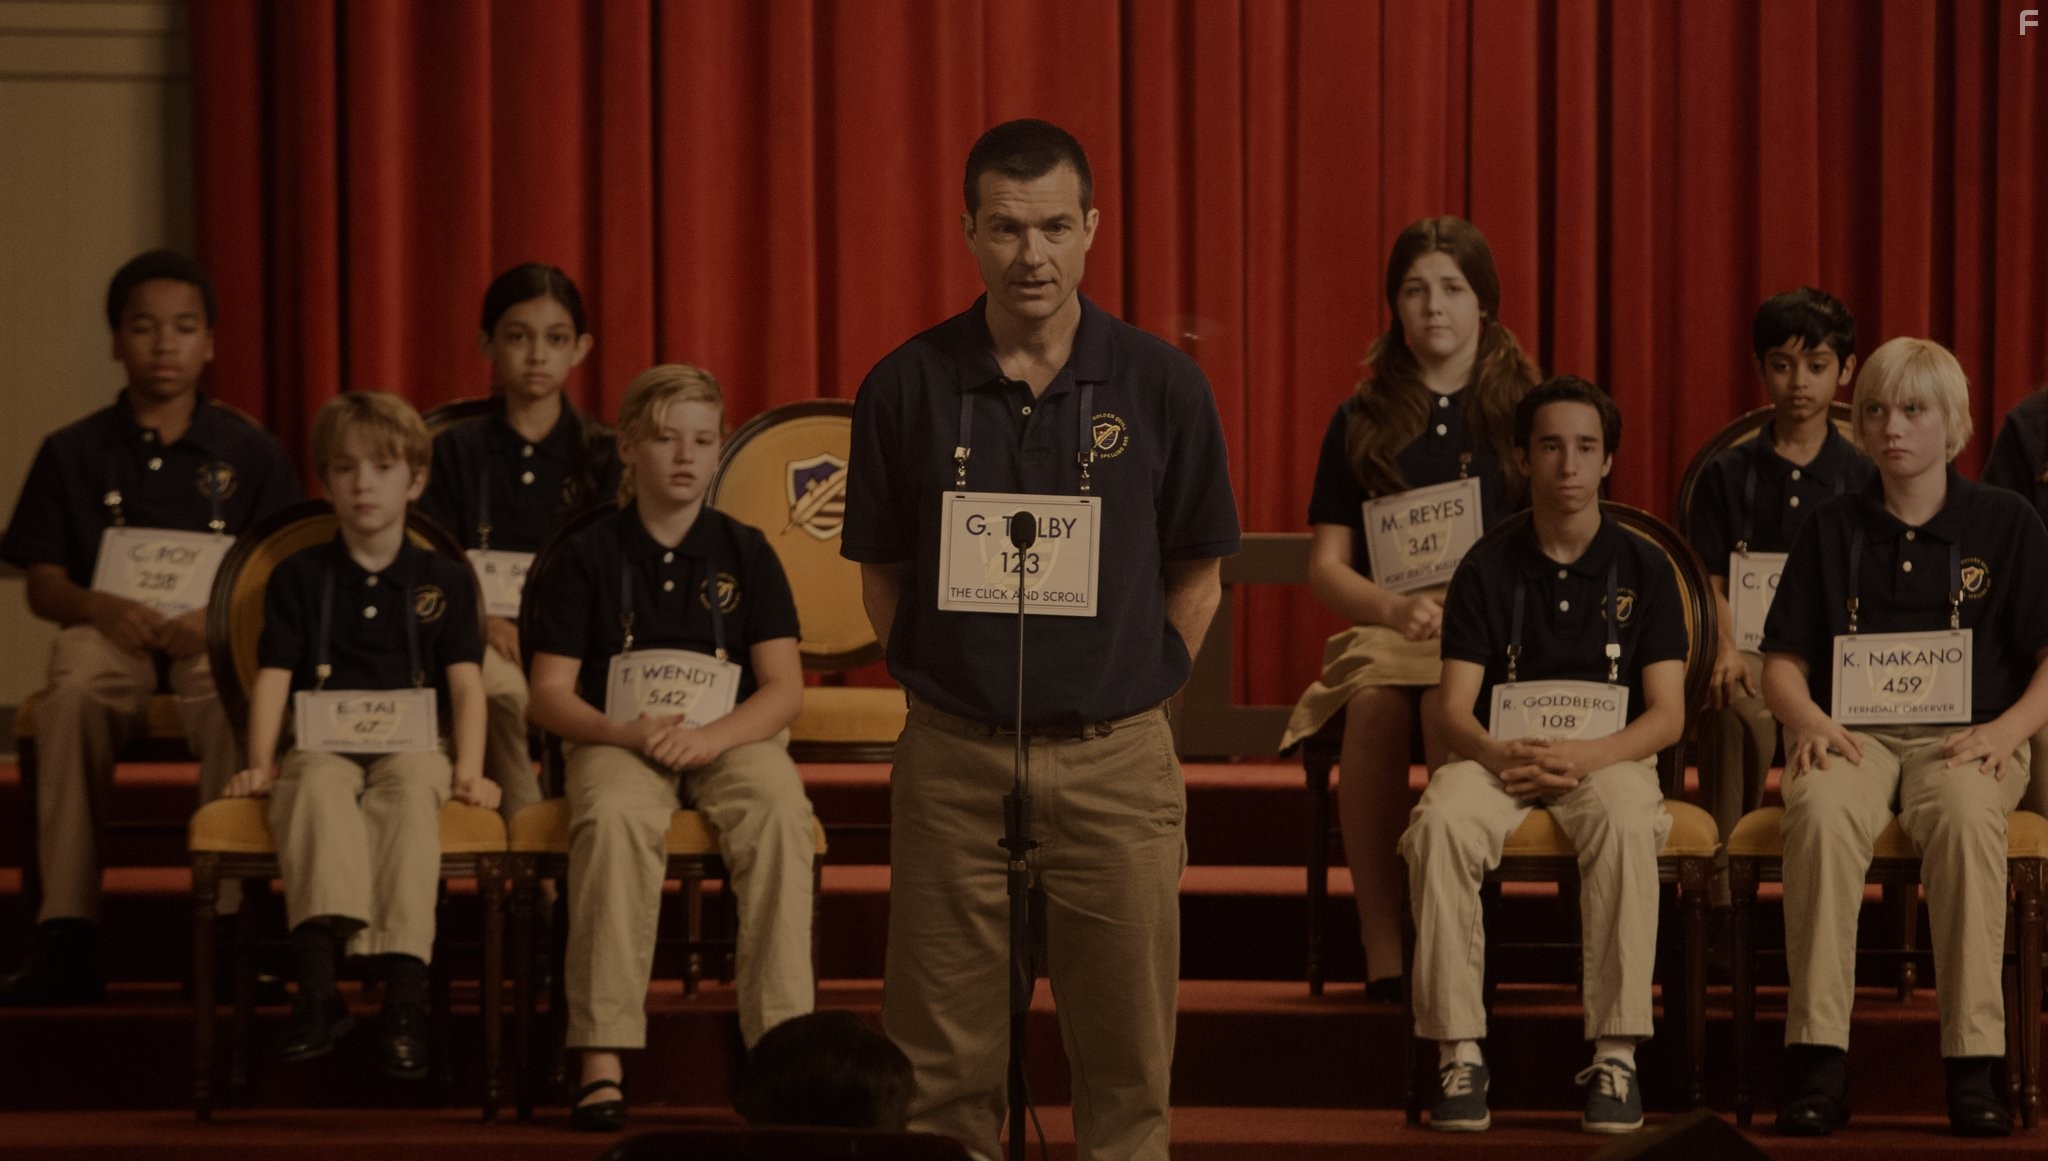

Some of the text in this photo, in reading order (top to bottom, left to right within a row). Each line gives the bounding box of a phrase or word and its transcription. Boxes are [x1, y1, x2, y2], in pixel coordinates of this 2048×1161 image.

[1381, 498, 1465, 533] M. REYES
[966, 514, 1077, 539] G. TLBY
[1408, 533, 1438, 556] 341
[1001, 552, 1040, 574] 123
[1742, 572, 1760, 590] C.
[951, 587, 1086, 603] THE CLICK AND SCROLL
[1843, 648, 1963, 667] K. NAKANO
[642, 664, 719, 687] WENDT
[1882, 676, 1922, 693] 459
[646, 689, 687, 706] 542
[1503, 695, 1616, 711] R. GOLDBERG
[1848, 703, 1955, 714] FERNDALE OBSERVER
[1542, 714, 1576, 728] 108
